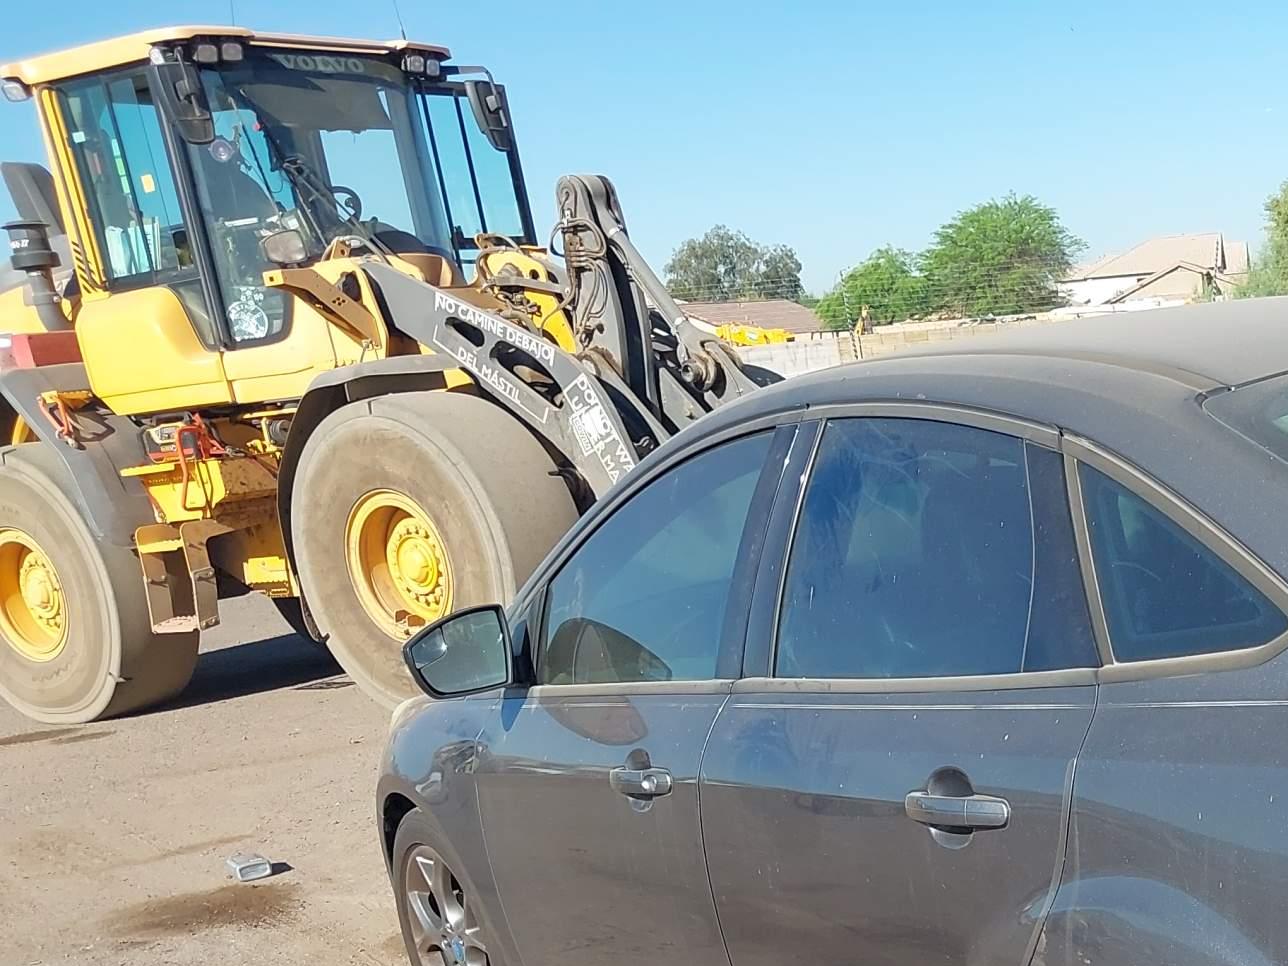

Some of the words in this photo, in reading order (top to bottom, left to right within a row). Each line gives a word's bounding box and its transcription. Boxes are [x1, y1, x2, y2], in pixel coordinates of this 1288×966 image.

[272, 54, 365, 73] VOLVO
[436, 294, 456, 313] NO
[457, 305, 504, 338] CAMINE
[506, 328, 551, 359] DEBAJO
[457, 347, 479, 372] DEL
[481, 364, 521, 402] MÁSTIL
[576, 377, 596, 404] DO
